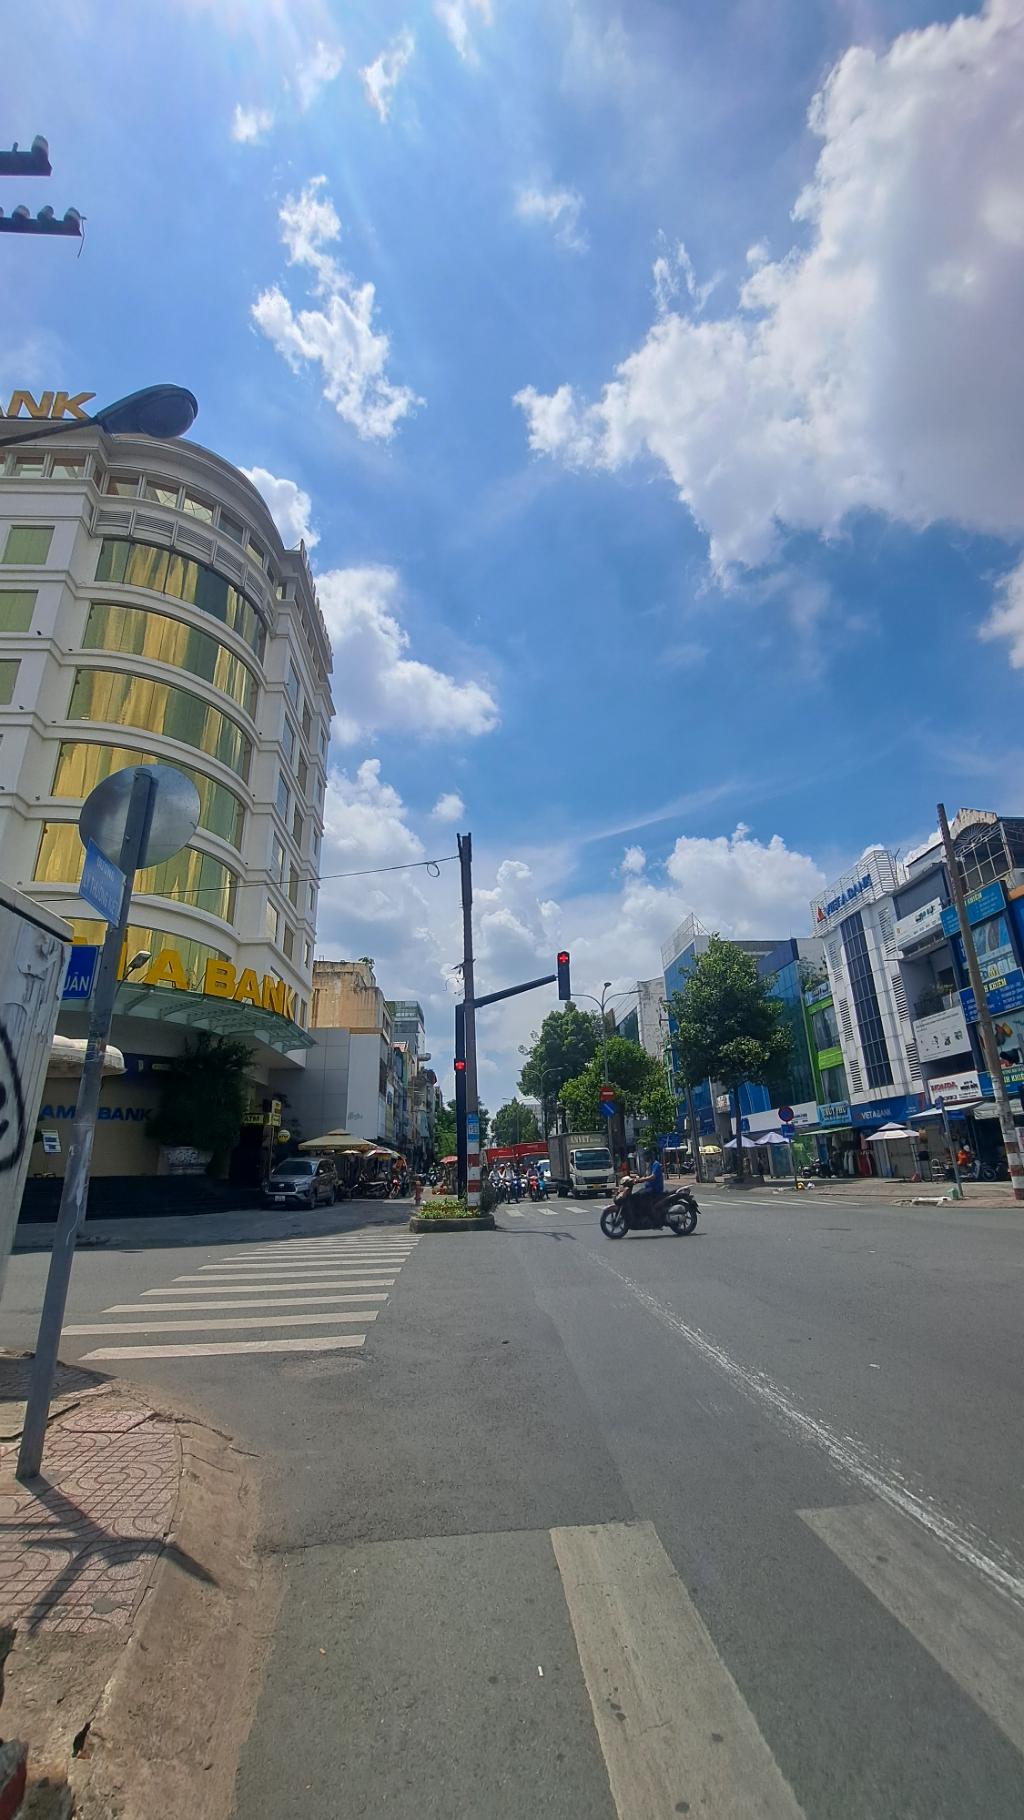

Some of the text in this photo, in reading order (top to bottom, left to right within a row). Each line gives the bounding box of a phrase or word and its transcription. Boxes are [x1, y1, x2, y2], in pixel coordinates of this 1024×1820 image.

[0, 390, 97, 418] NK
[143, 949, 189, 990] A
[203, 957, 296, 1021] BANK
[97, 1107, 152, 1120] BANK
